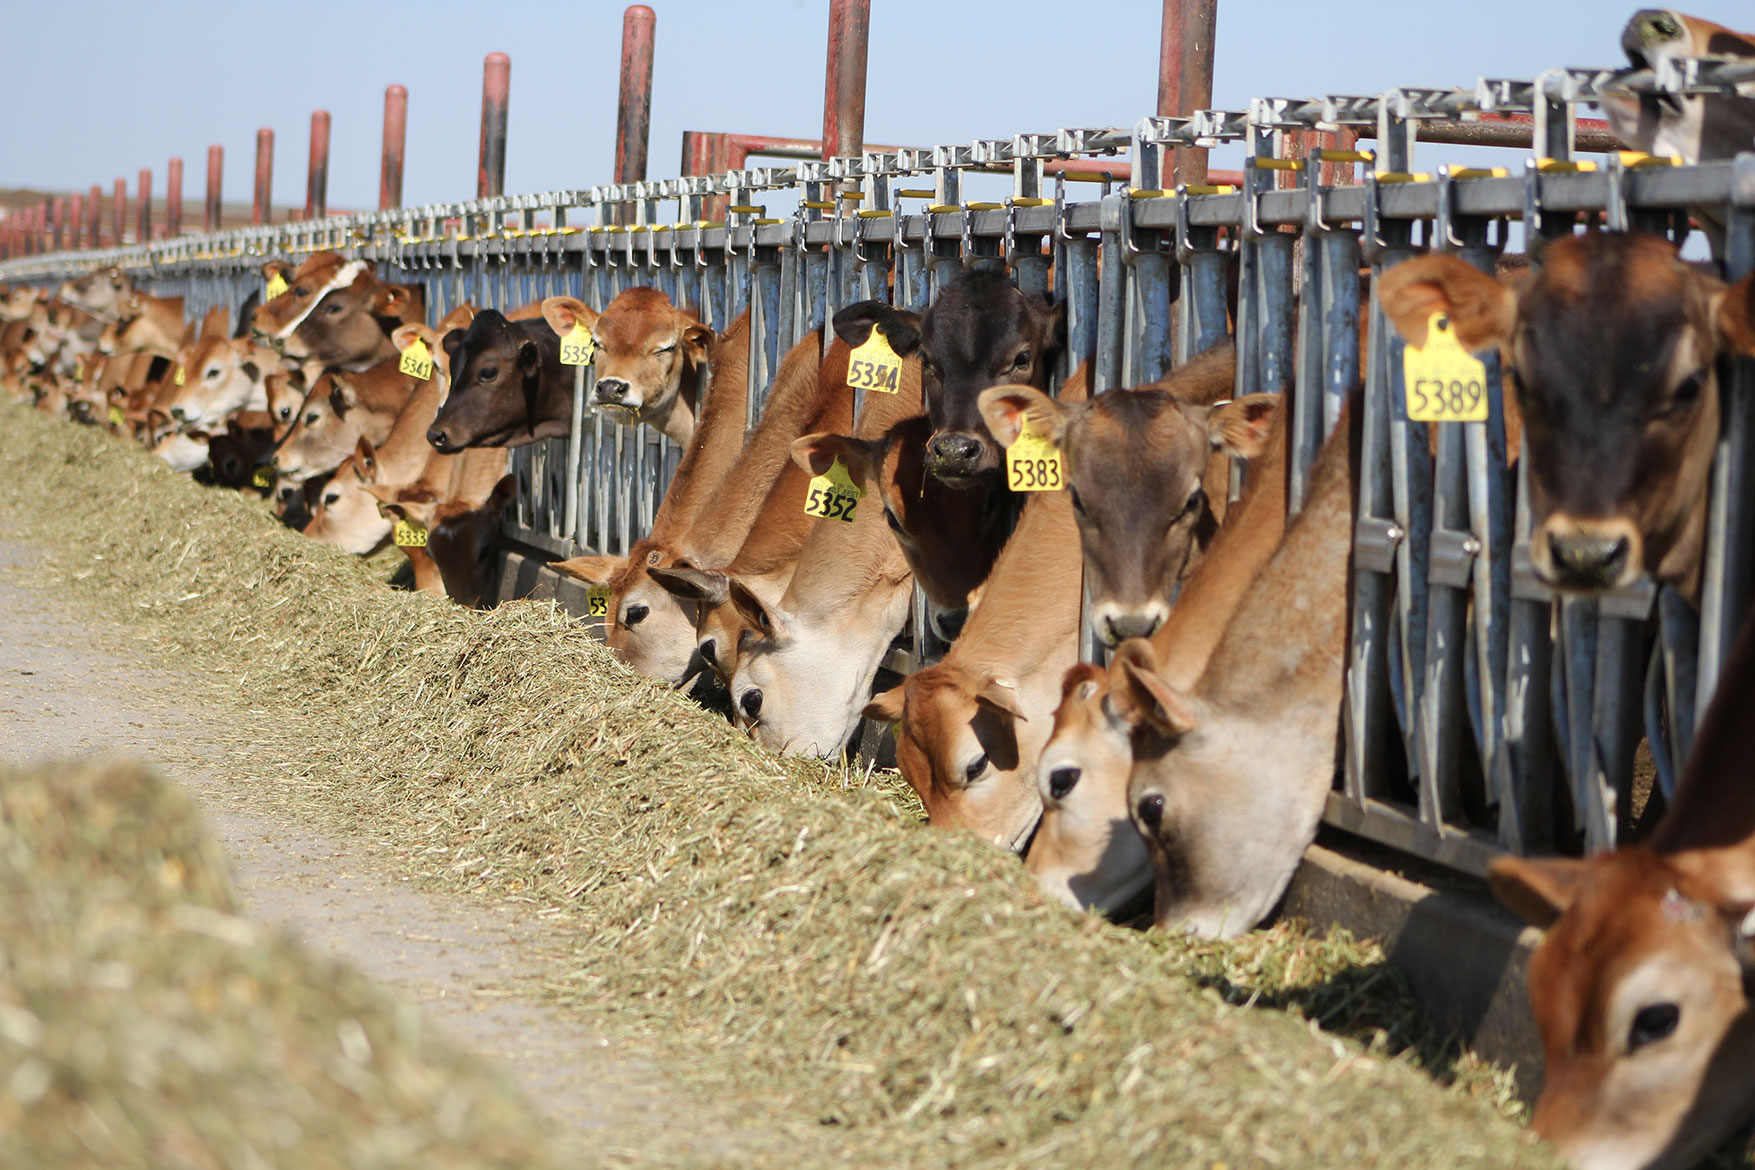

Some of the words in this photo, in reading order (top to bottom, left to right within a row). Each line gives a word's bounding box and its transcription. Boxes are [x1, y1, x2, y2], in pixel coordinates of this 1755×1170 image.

[402, 356, 429, 379] 5341
[849, 360, 899, 391] 5354
[1414, 379, 1481, 414] 5389
[1013, 459, 1060, 487] 5383
[806, 489, 857, 522] 5352
[398, 529, 426, 545] 5333
